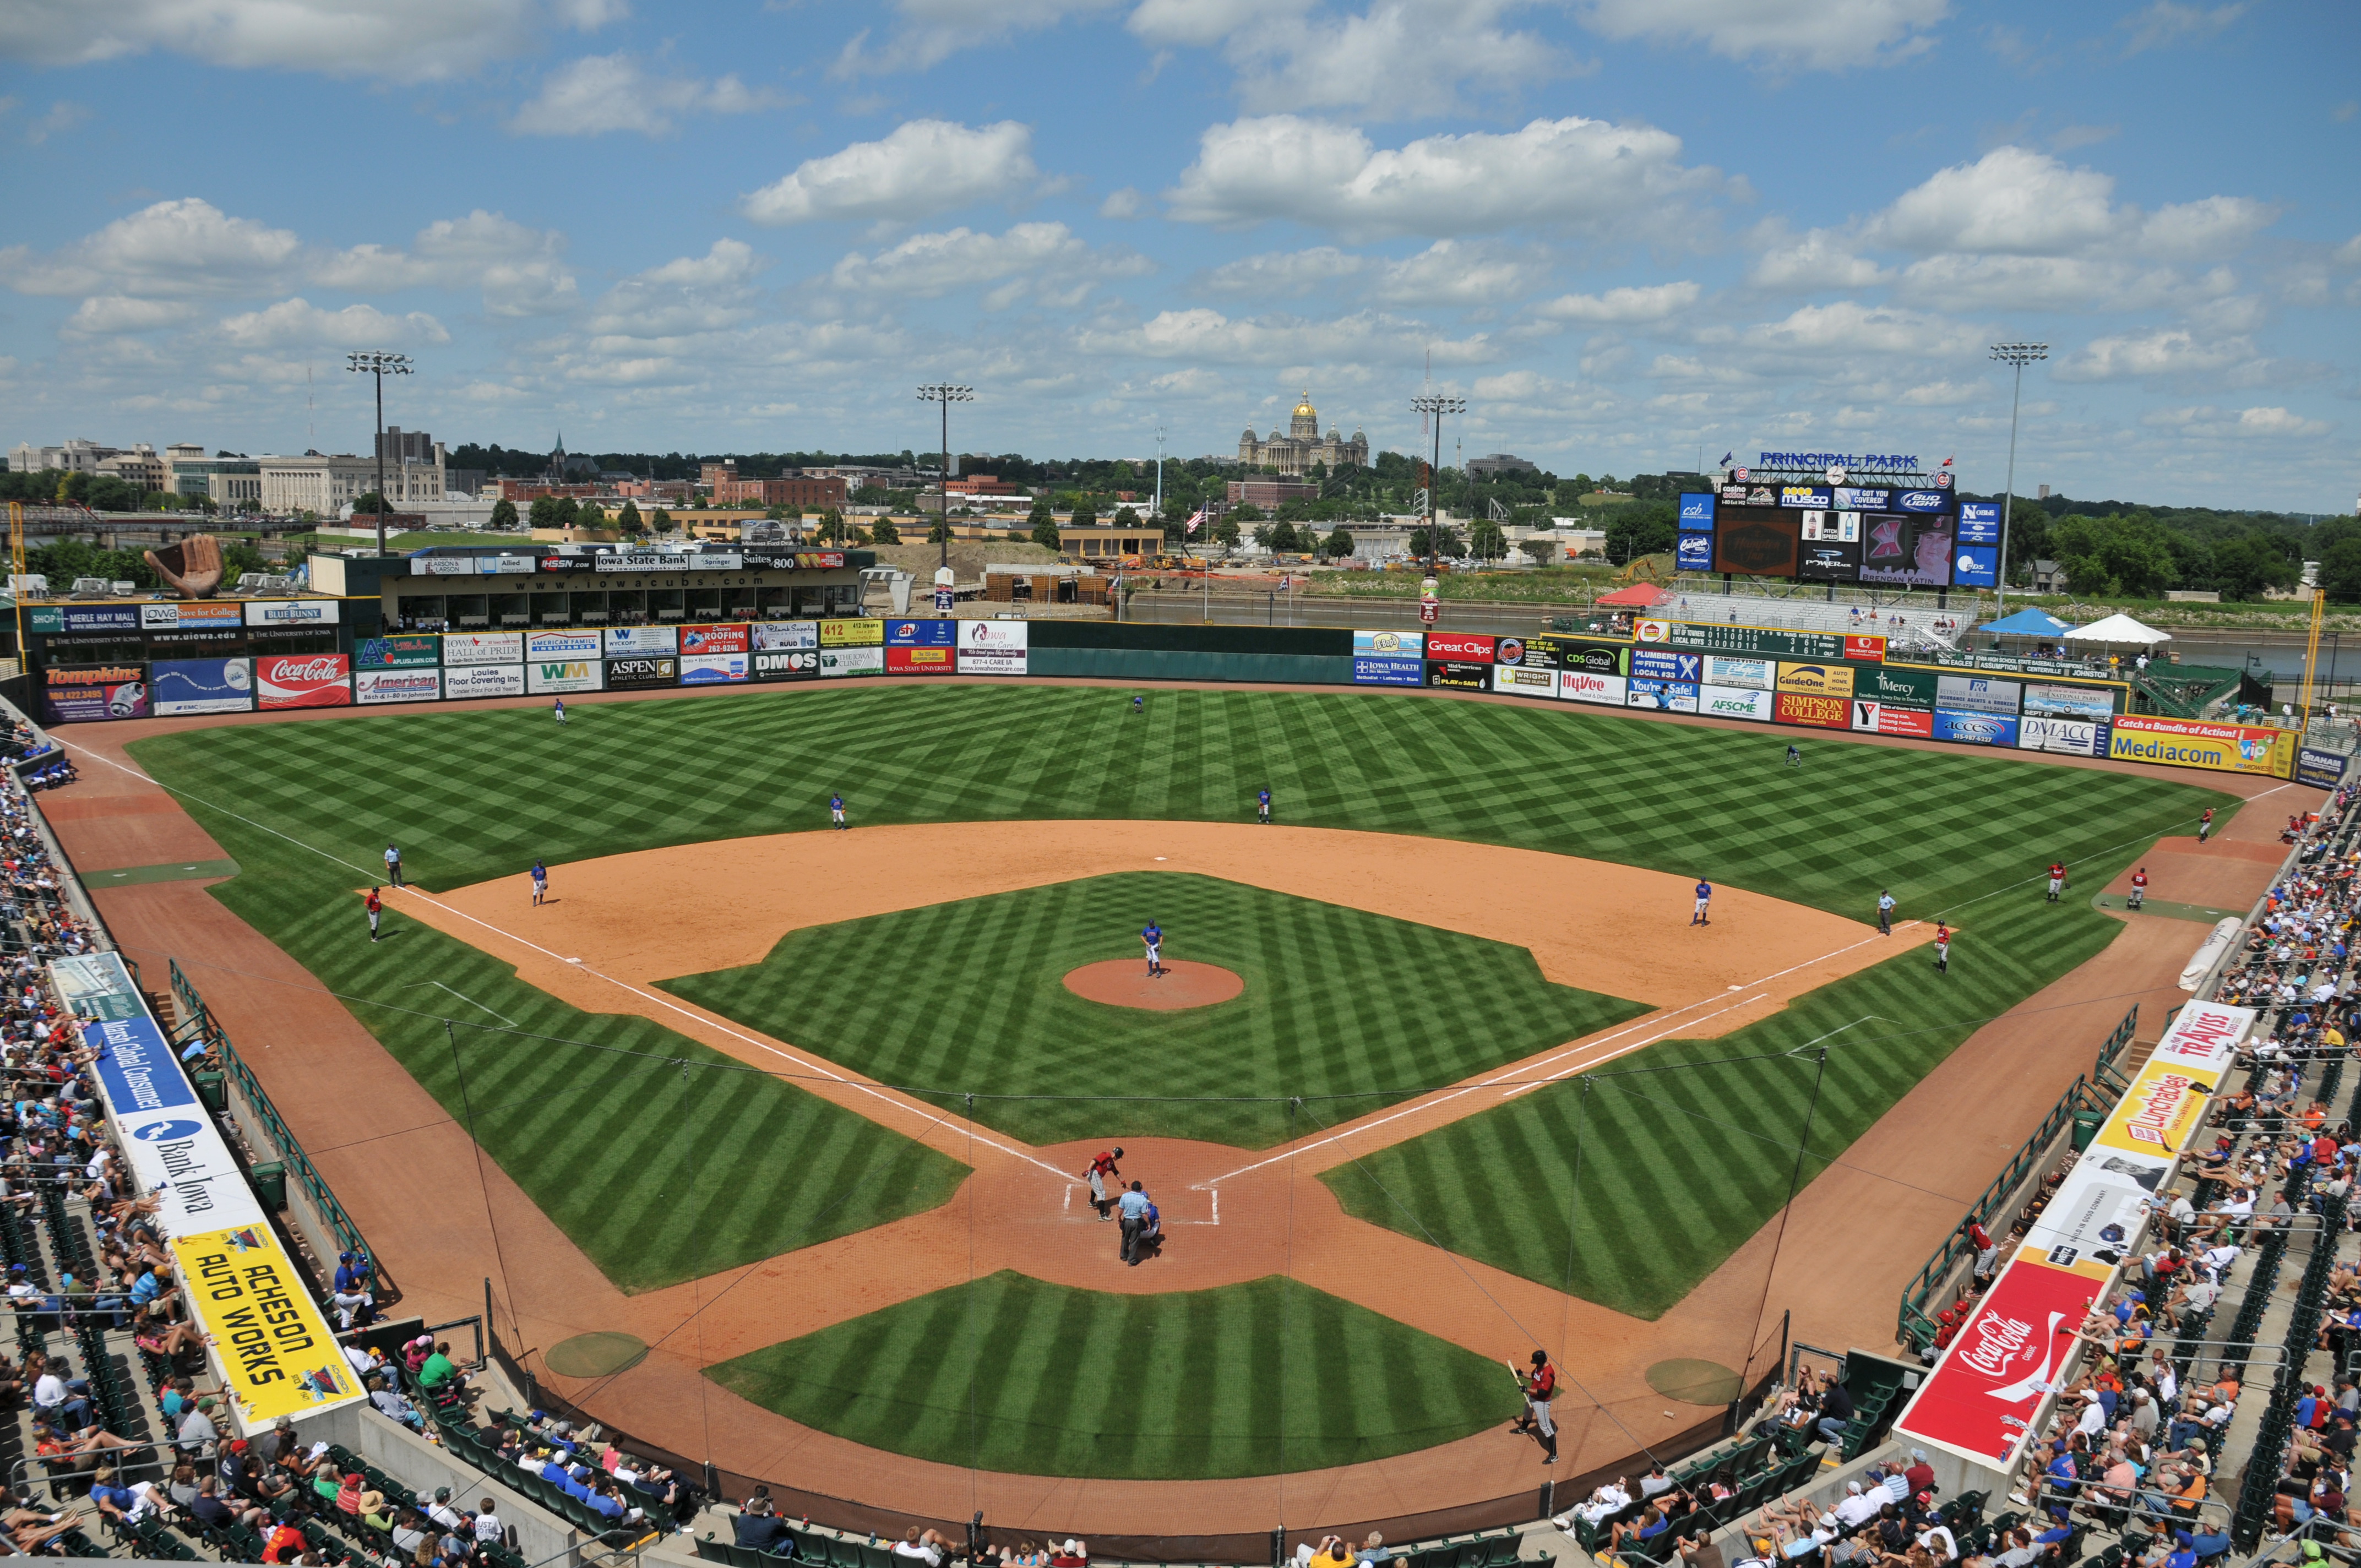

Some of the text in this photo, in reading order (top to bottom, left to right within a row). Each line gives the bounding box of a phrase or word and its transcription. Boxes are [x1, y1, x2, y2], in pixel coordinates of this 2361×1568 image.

[1760, 452, 1918, 467] PRINCIPAL PARK
[597, 555, 686, 565] Iowa State Bank
[743, 554, 793, 568] Suites 800
[70, 614, 94, 622] MERLE
[115, 613, 135, 621] MALL
[211, 608, 239, 618] College
[179, 618, 241, 627] collegesavingsiowa.com
[824, 624, 844, 636] 412
[154, 632, 236, 641] www.uiowa.edu
[705, 631, 744, 640] ROOFING
[447, 648, 475, 656] HALL
[975, 640, 994, 649] Home
[1429, 641, 1492, 656] Great Clips
[1566, 654, 1610, 666] CDS Global
[1636, 651, 1677, 660] PLUMBERS
[1951, 659, 1972, 667] EAGLES
[271, 657, 341, 682] Coca-Cola
[611, 661, 655, 675] ASPEN
[1980, 662, 2017, 671] ASSUMPTION
[2027, 666, 2061, 674] CENTERVILLE
[2072, 670, 2107, 678] JOHNSTON
[46, 667, 142, 685] Tompkins
[357, 676, 438, 691] American
[1779, 676, 1824, 688] GuideOne
[1633, 680, 1692, 695] You're Safe!
[1883, 680, 1914, 696] Mercy
[1711, 700, 1756, 712] AFSCME
[1783, 695, 1843, 710] SIMPSON
[1781, 706, 1842, 721] COLLEGE
[1944, 719, 1997, 734] access
[2025, 721, 2093, 739] DMACC
[2118, 720, 2142, 729] Catch
[2153, 722, 2186, 733] Bundle
[2188, 725, 2199, 734] of
[2200, 727, 2237, 738] Action!
[2114, 738, 2221, 765] Mediacom
[2239, 744, 2266, 758] vip
[2301, 751, 2342, 766] GRAHAM
[100, 1021, 130, 1044] Marsh
[2178, 1012, 2231, 1058] TRAVISS
[111, 1042, 145, 1069] Global
[123, 1064, 163, 1110] Consumer
[2131, 1075, 2189, 1129] Lunchables
[156, 1140, 213, 1213] Bank Iowa
[2055, 1246, 2072, 1264] WEITZ
[242, 1265, 314, 1353] ACHESON
[196, 1254, 286, 1385] AUTO WORKS
[1959, 1309, 2032, 1376] Coca-Cola
